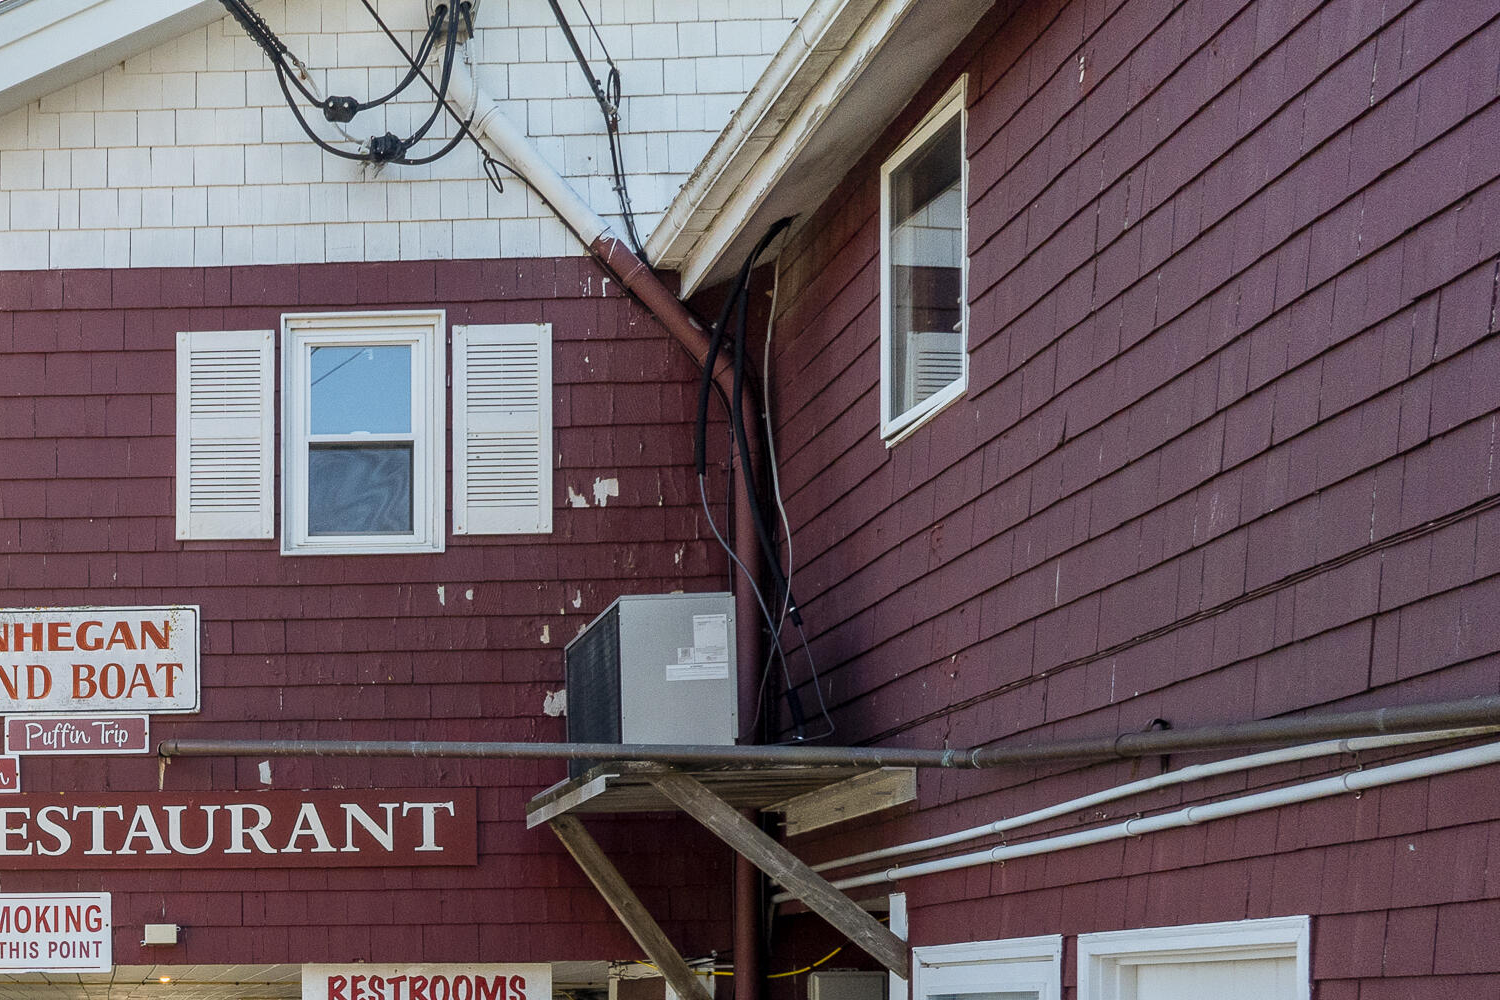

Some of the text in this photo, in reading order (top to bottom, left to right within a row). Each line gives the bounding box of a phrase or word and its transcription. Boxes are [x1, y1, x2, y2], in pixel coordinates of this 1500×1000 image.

[71, 662, 184, 700] BOAT
[24, 721, 129, 750] Puffin Trip
[49, 940, 103, 960] POINT
